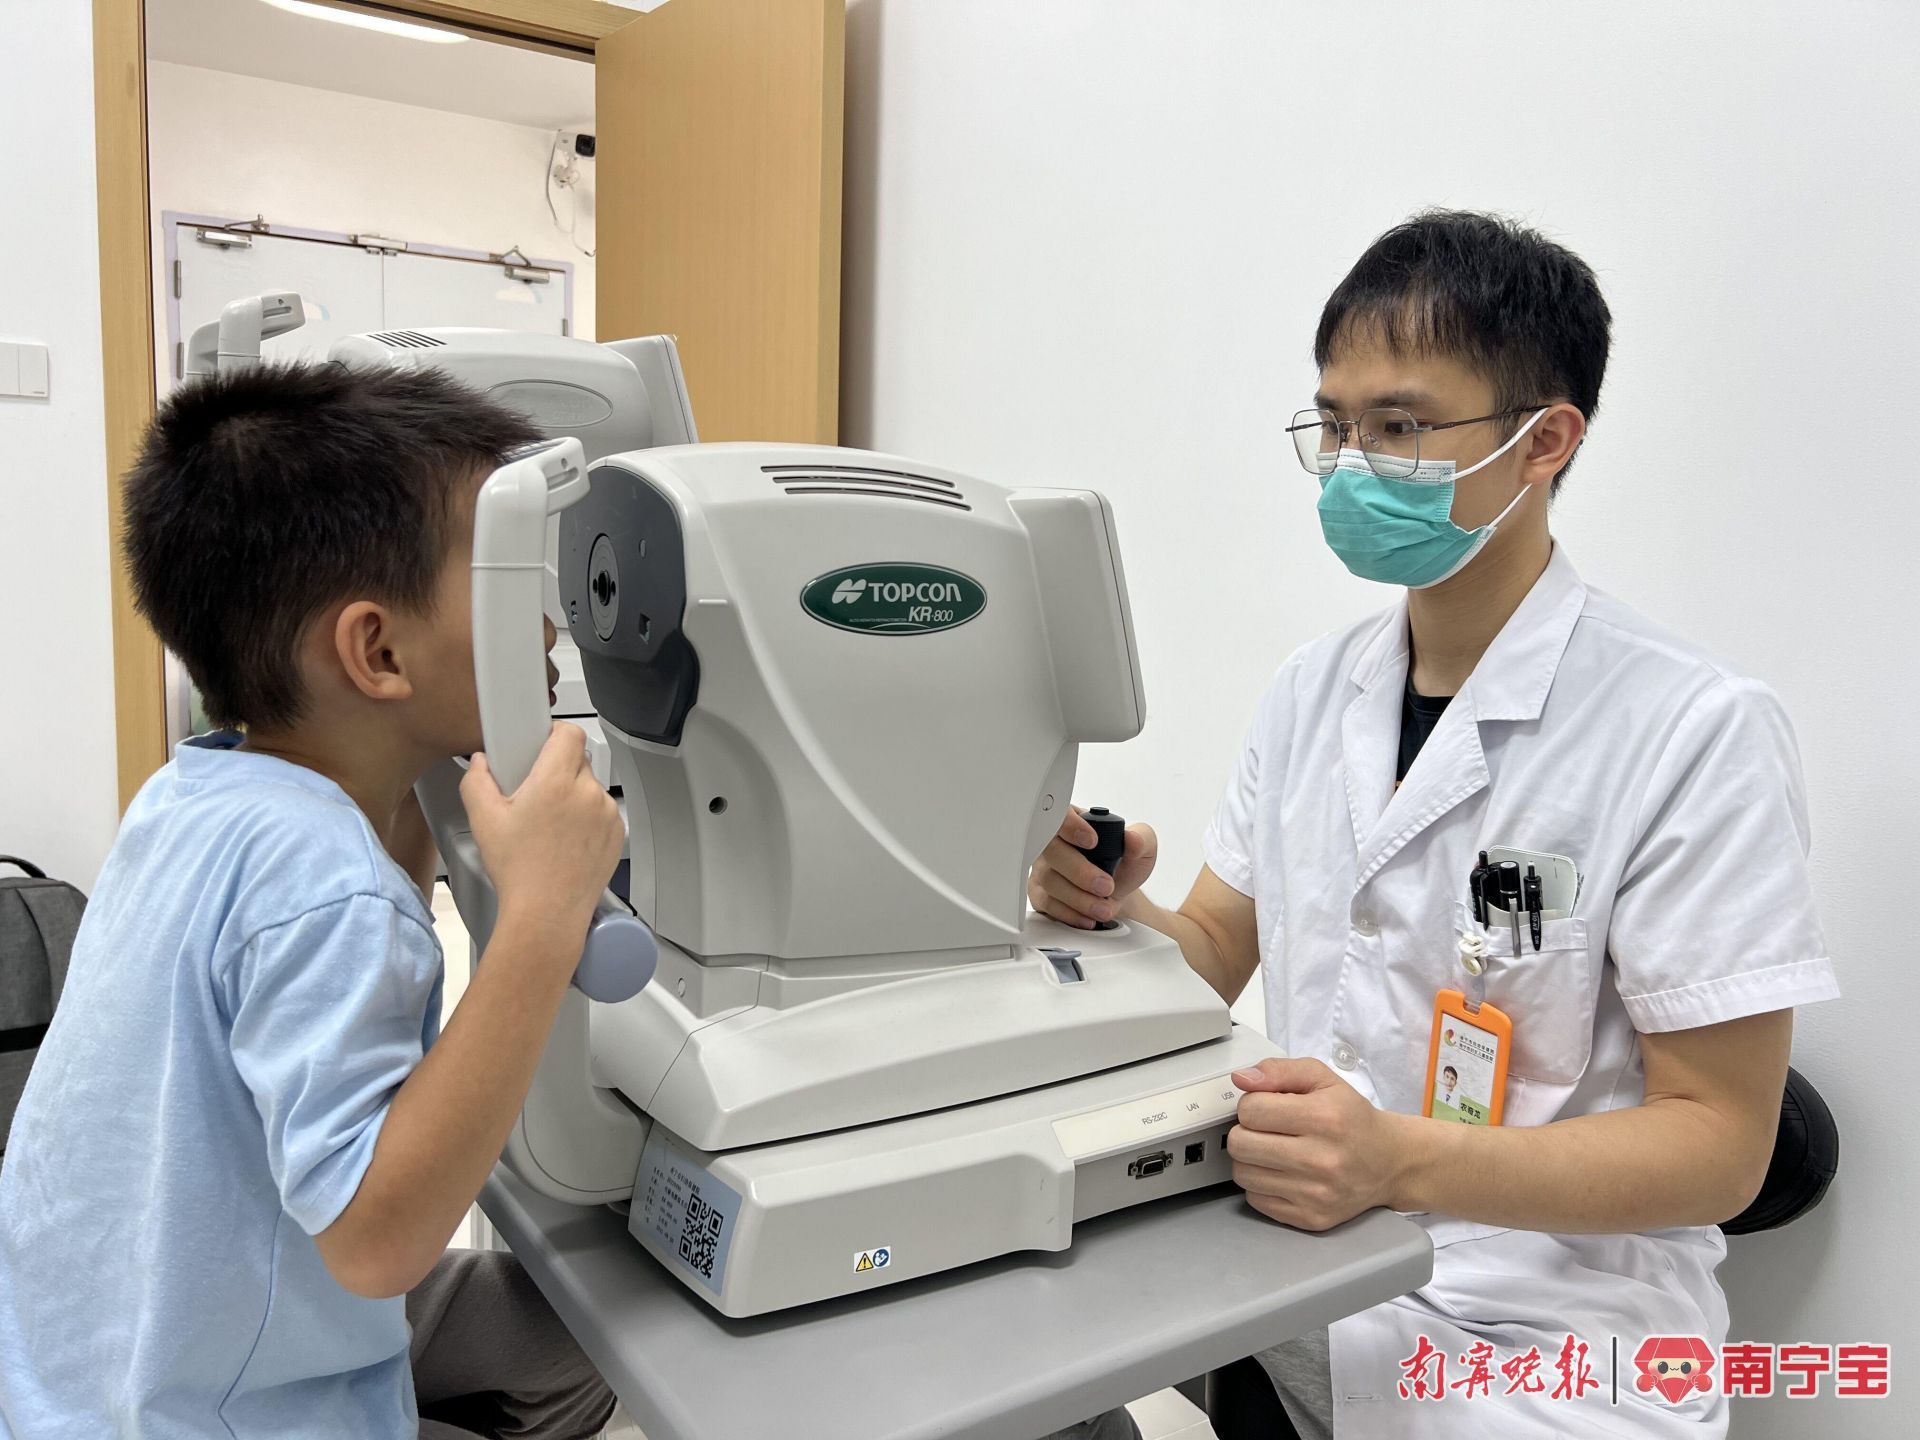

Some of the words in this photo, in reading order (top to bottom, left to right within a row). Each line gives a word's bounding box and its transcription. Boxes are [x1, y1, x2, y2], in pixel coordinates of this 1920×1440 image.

[867, 582, 962, 603] TOPCON
[1221, 1091, 1235, 1101] USB
[1186, 1102, 1200, 1112] LAN
[1141, 1112, 1168, 1125] RS-232C
